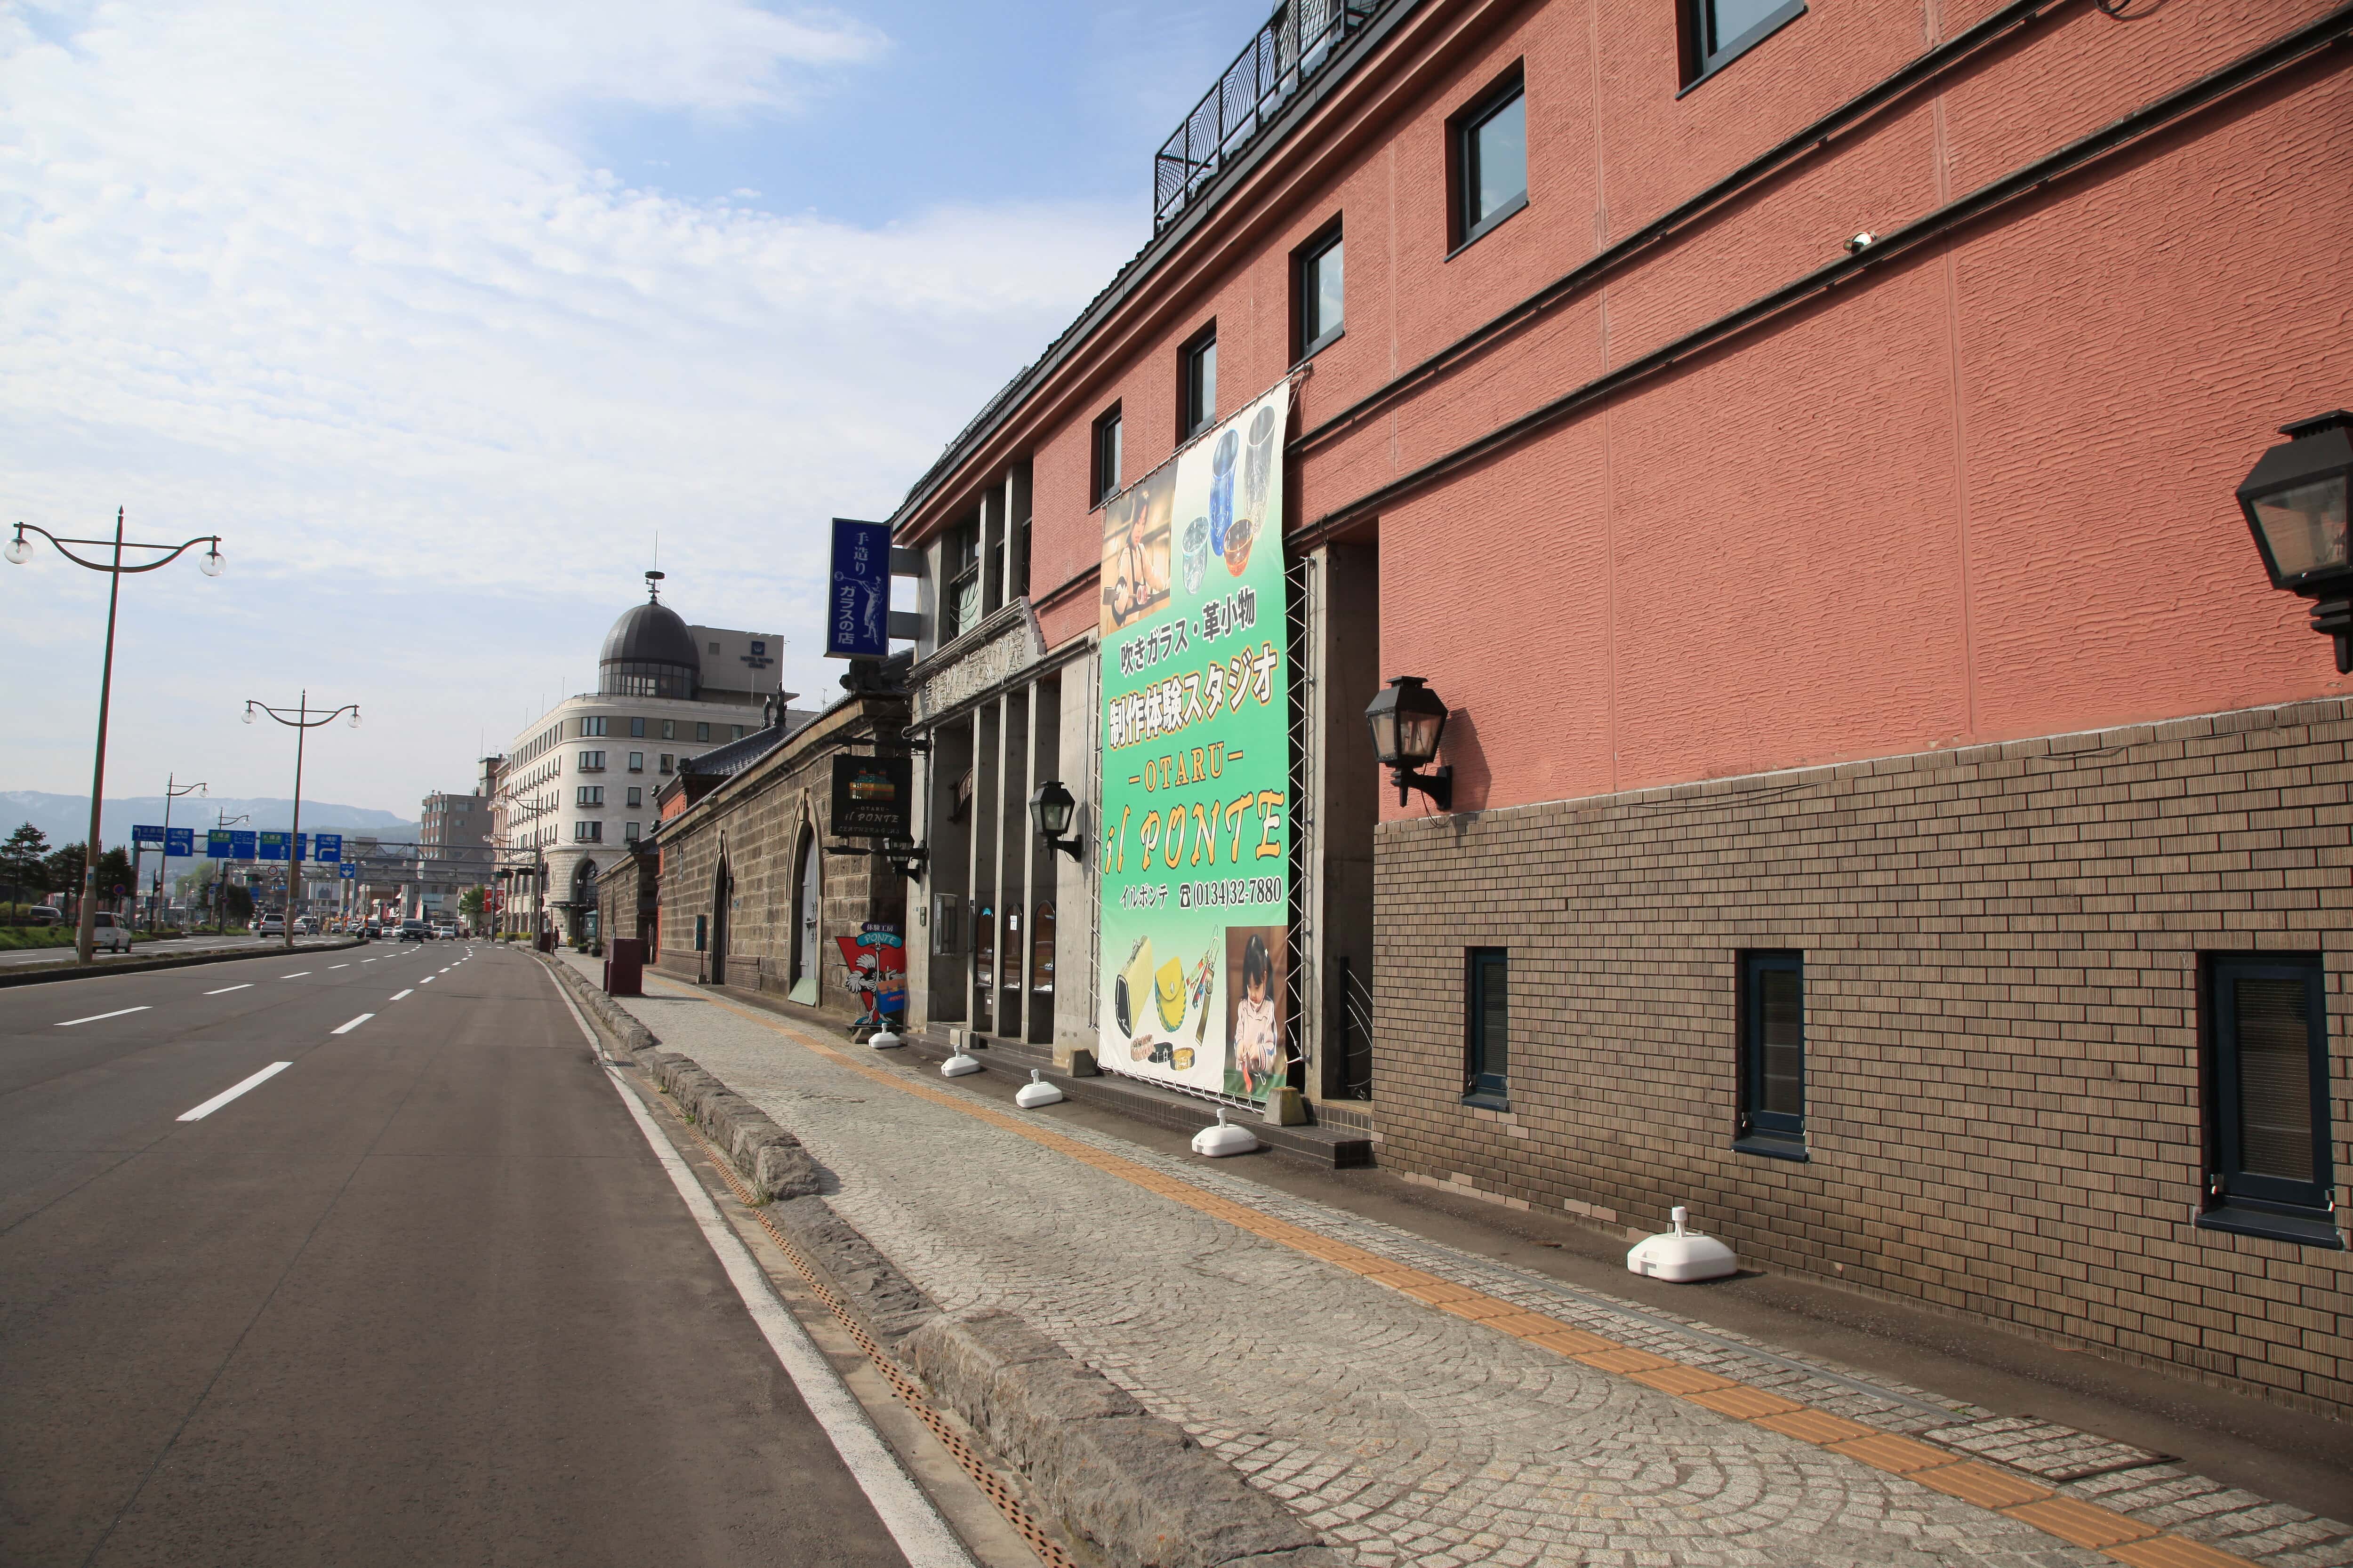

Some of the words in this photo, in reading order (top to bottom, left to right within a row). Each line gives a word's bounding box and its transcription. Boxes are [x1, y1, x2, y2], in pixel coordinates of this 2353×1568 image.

[854, 532, 870, 575] 手造り
[837, 585, 856, 645] ガラスの店
[1119, 587, 1256, 678] 吹きガラス・革小物
[1108, 643, 1279, 749] 制作体験スタジオ
[858, 813, 899, 823] PONTE
[1104, 804, 1131, 875] il
[1140, 789, 1285, 872] PONTE
[1119, 884, 1168, 910] イルポンテ
[1193, 876, 1282, 911] (0134)32-7880
[864, 932, 897, 945] PONTE
